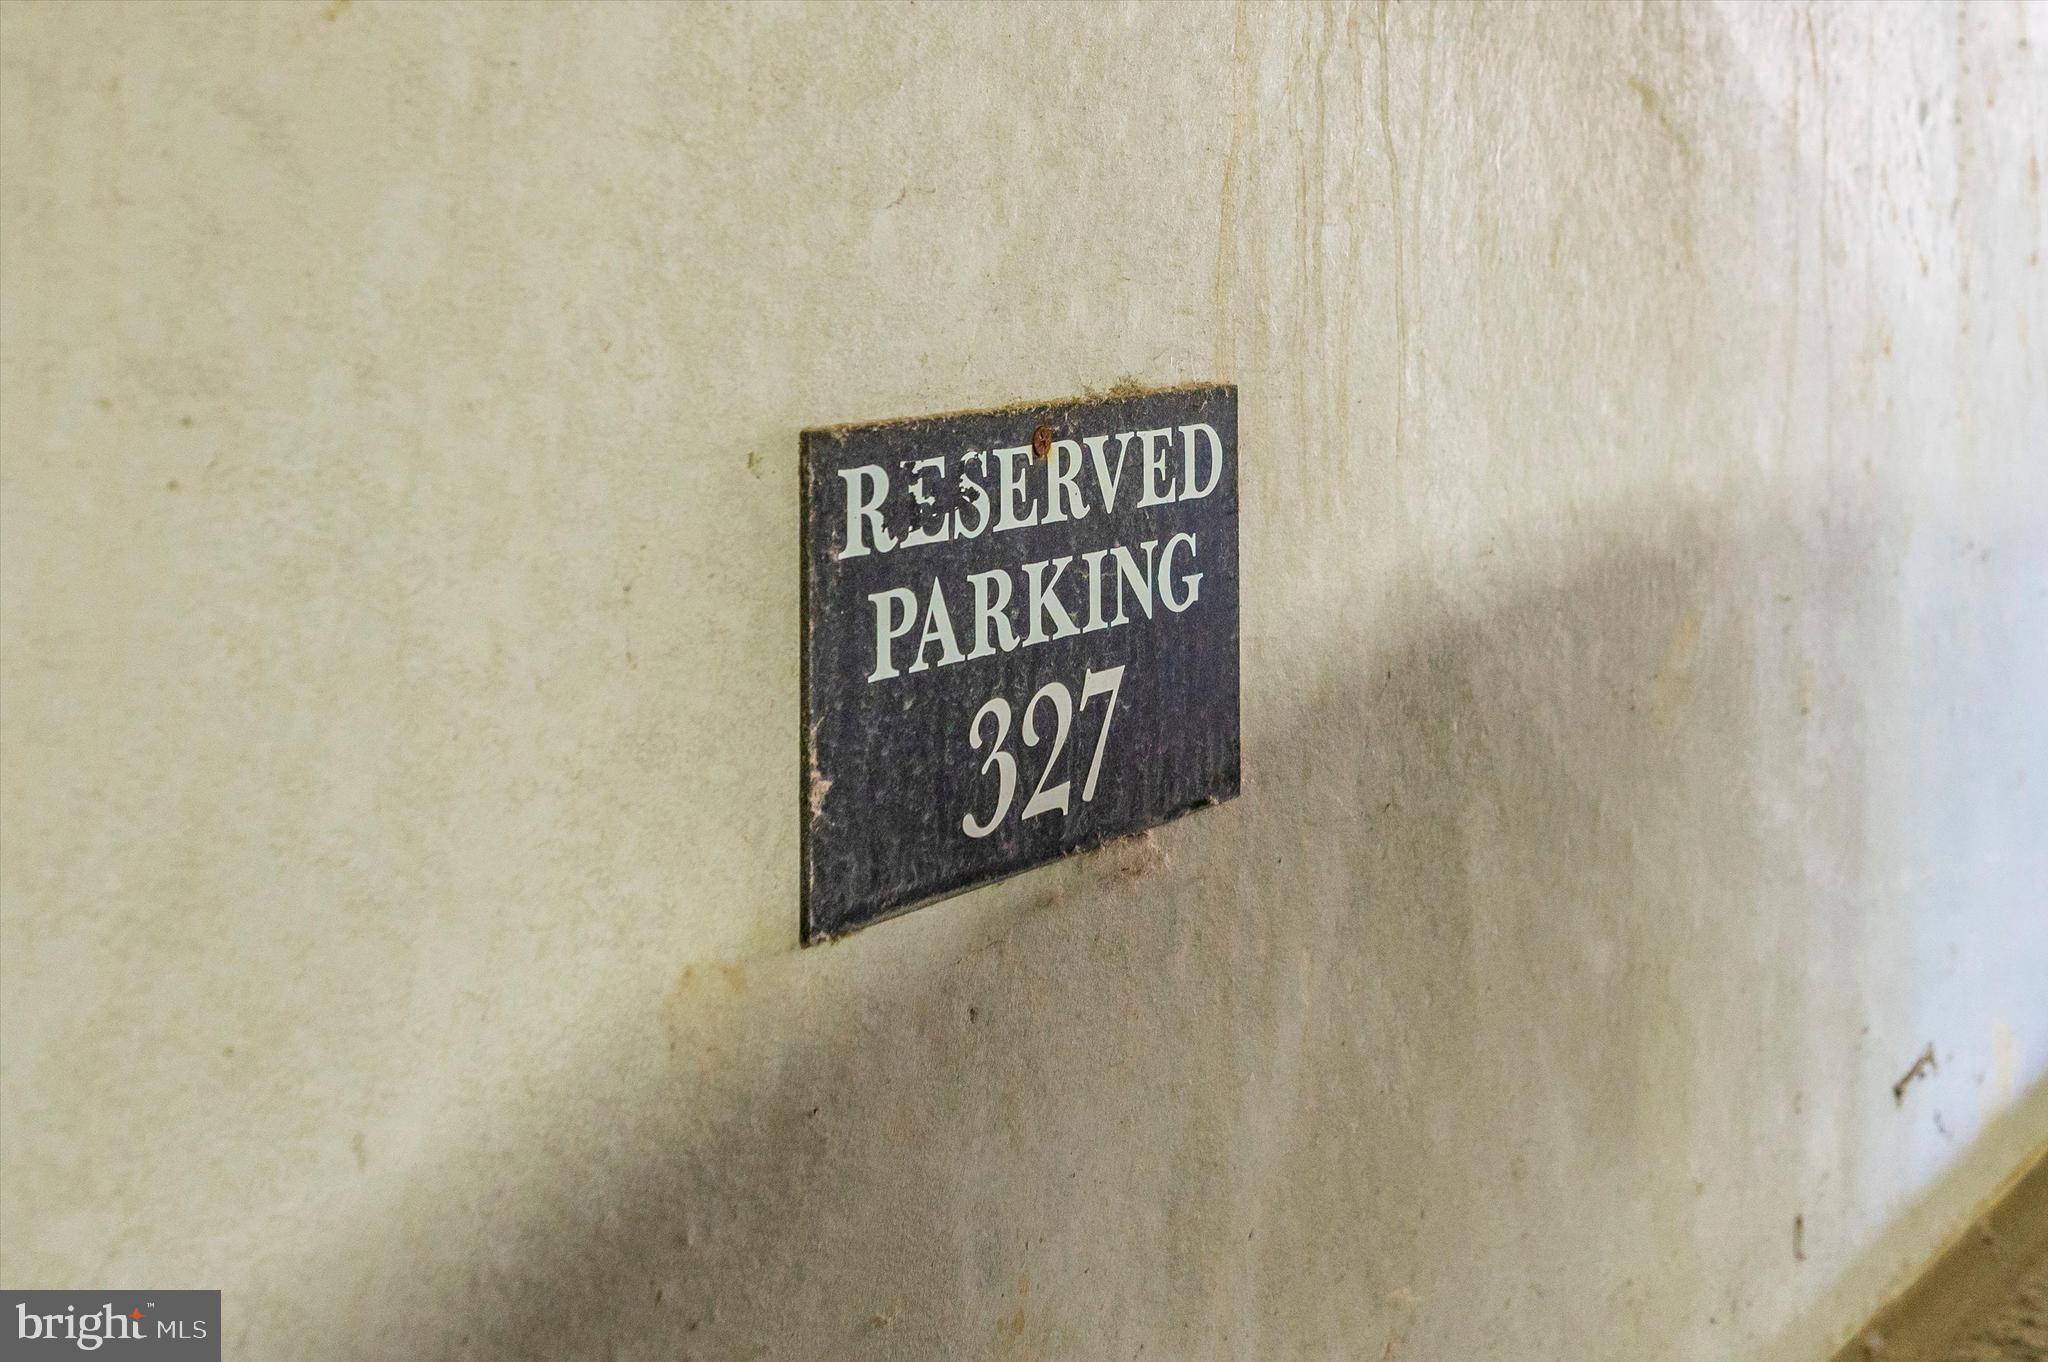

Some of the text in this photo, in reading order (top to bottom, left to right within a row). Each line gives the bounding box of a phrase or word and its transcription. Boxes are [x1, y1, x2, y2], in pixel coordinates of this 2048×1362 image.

[838, 423, 1223, 560] RESERVED
[868, 532, 1204, 683] PARKING
[962, 665, 1126, 839] 327
